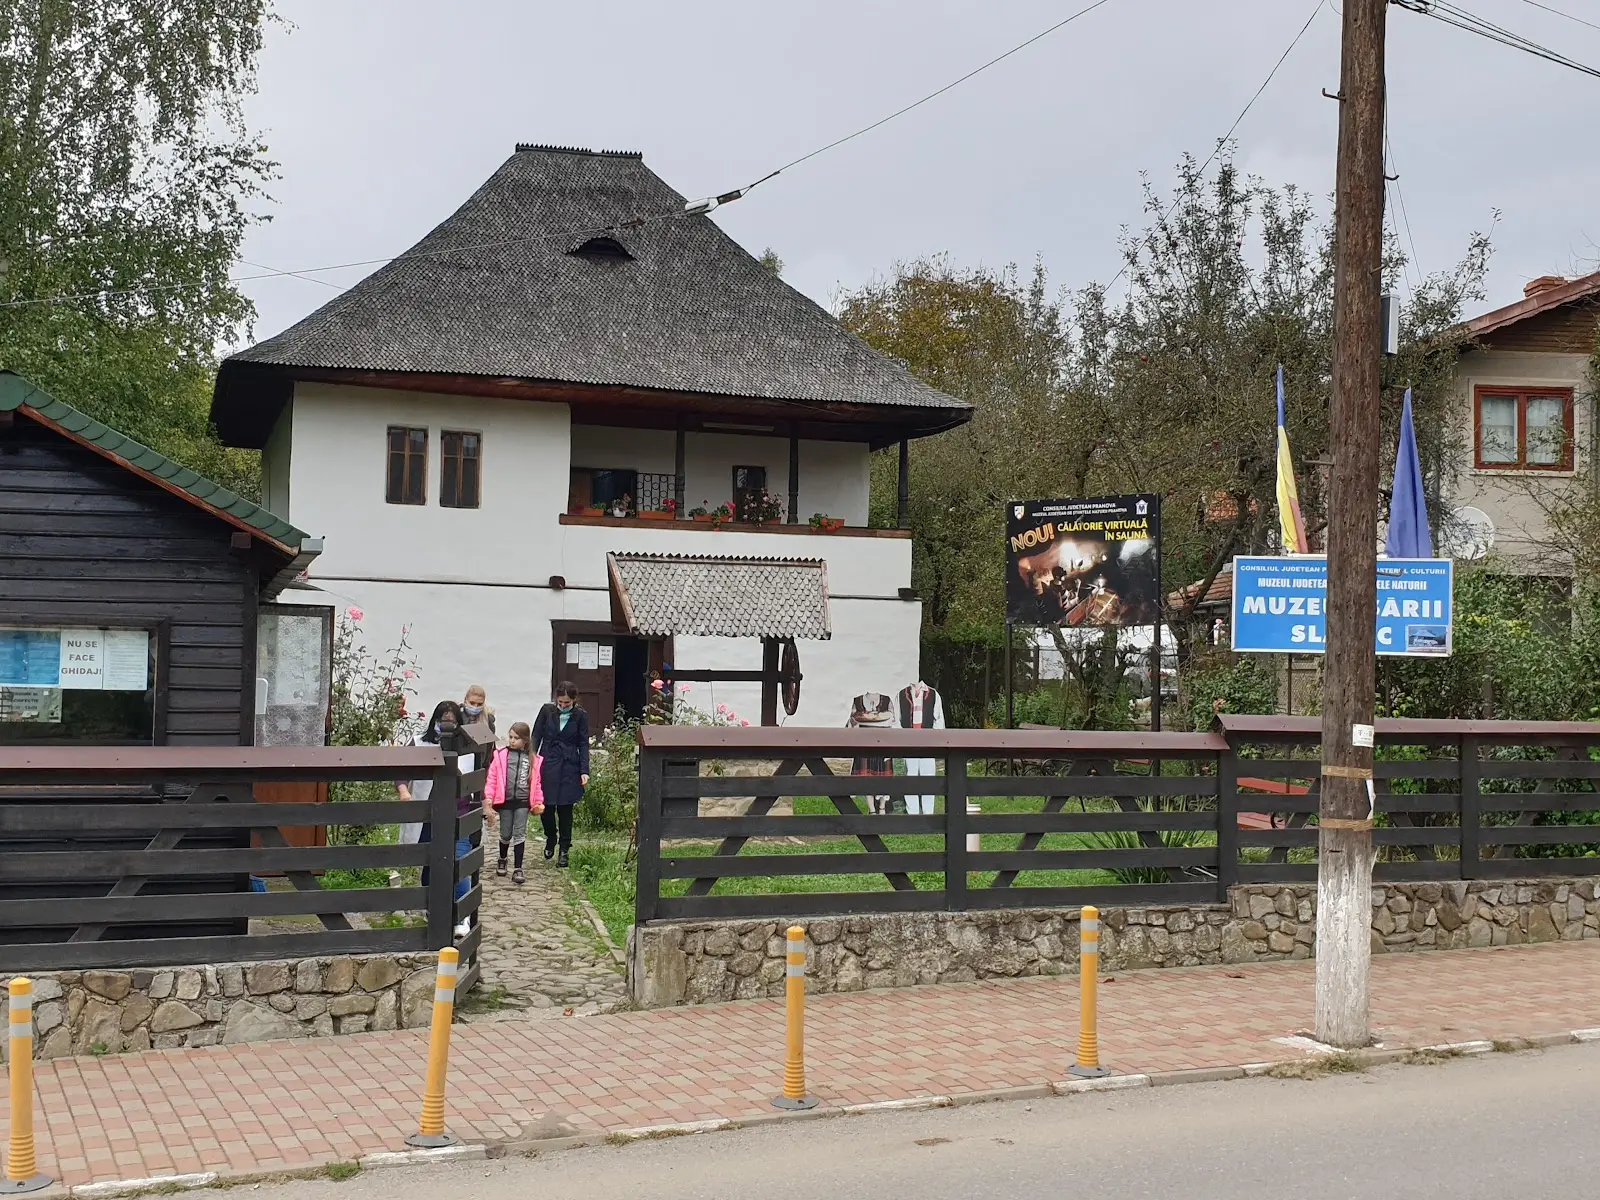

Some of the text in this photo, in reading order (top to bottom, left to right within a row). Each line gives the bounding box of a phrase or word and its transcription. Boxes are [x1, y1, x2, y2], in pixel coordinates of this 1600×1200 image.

[1057, 517, 1148, 532] CĂLĂTORIE VIRTUALĂ
[1010, 522, 1055, 552] NOU!
[1104, 529, 1148, 541] ÎN SALINĂ
[1257, 577, 1291, 588] MUZEUL
[1292, 578, 1327, 589] JUDETEA
[1391, 580, 1427, 590] NATURII
[1242, 596, 1442, 618] MUZE ĂRII
[67, 640, 98, 648] NU SE
[69, 653, 95, 662] FACE
